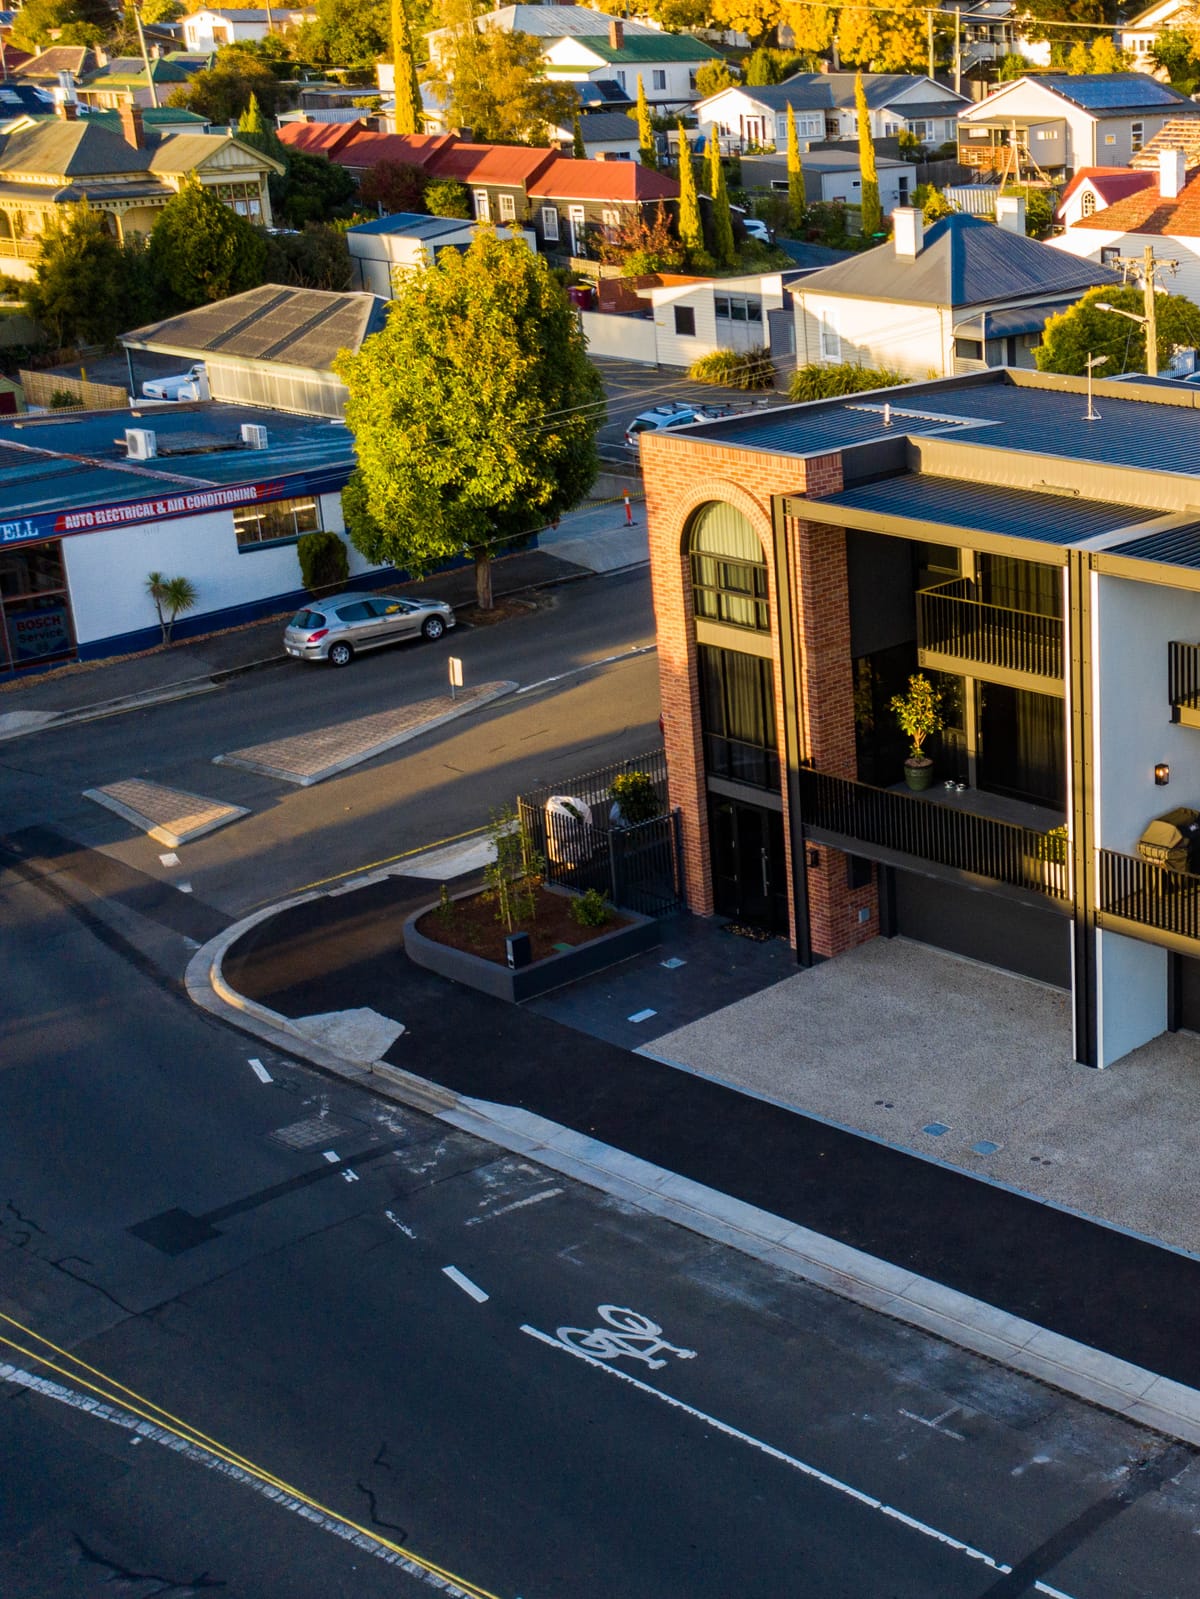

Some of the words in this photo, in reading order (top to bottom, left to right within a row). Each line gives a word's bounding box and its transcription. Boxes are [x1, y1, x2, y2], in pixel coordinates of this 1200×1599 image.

[65, 512, 94, 529] AUTO
[95, 503, 155, 524] ELECTRICAL
[156, 500, 166, 514] &
[167, 496, 185, 512] AIR
[187, 487, 257, 509] CONDITIONING
[16, 616, 60, 631] BOSCH
[18, 628, 63, 643] Service
